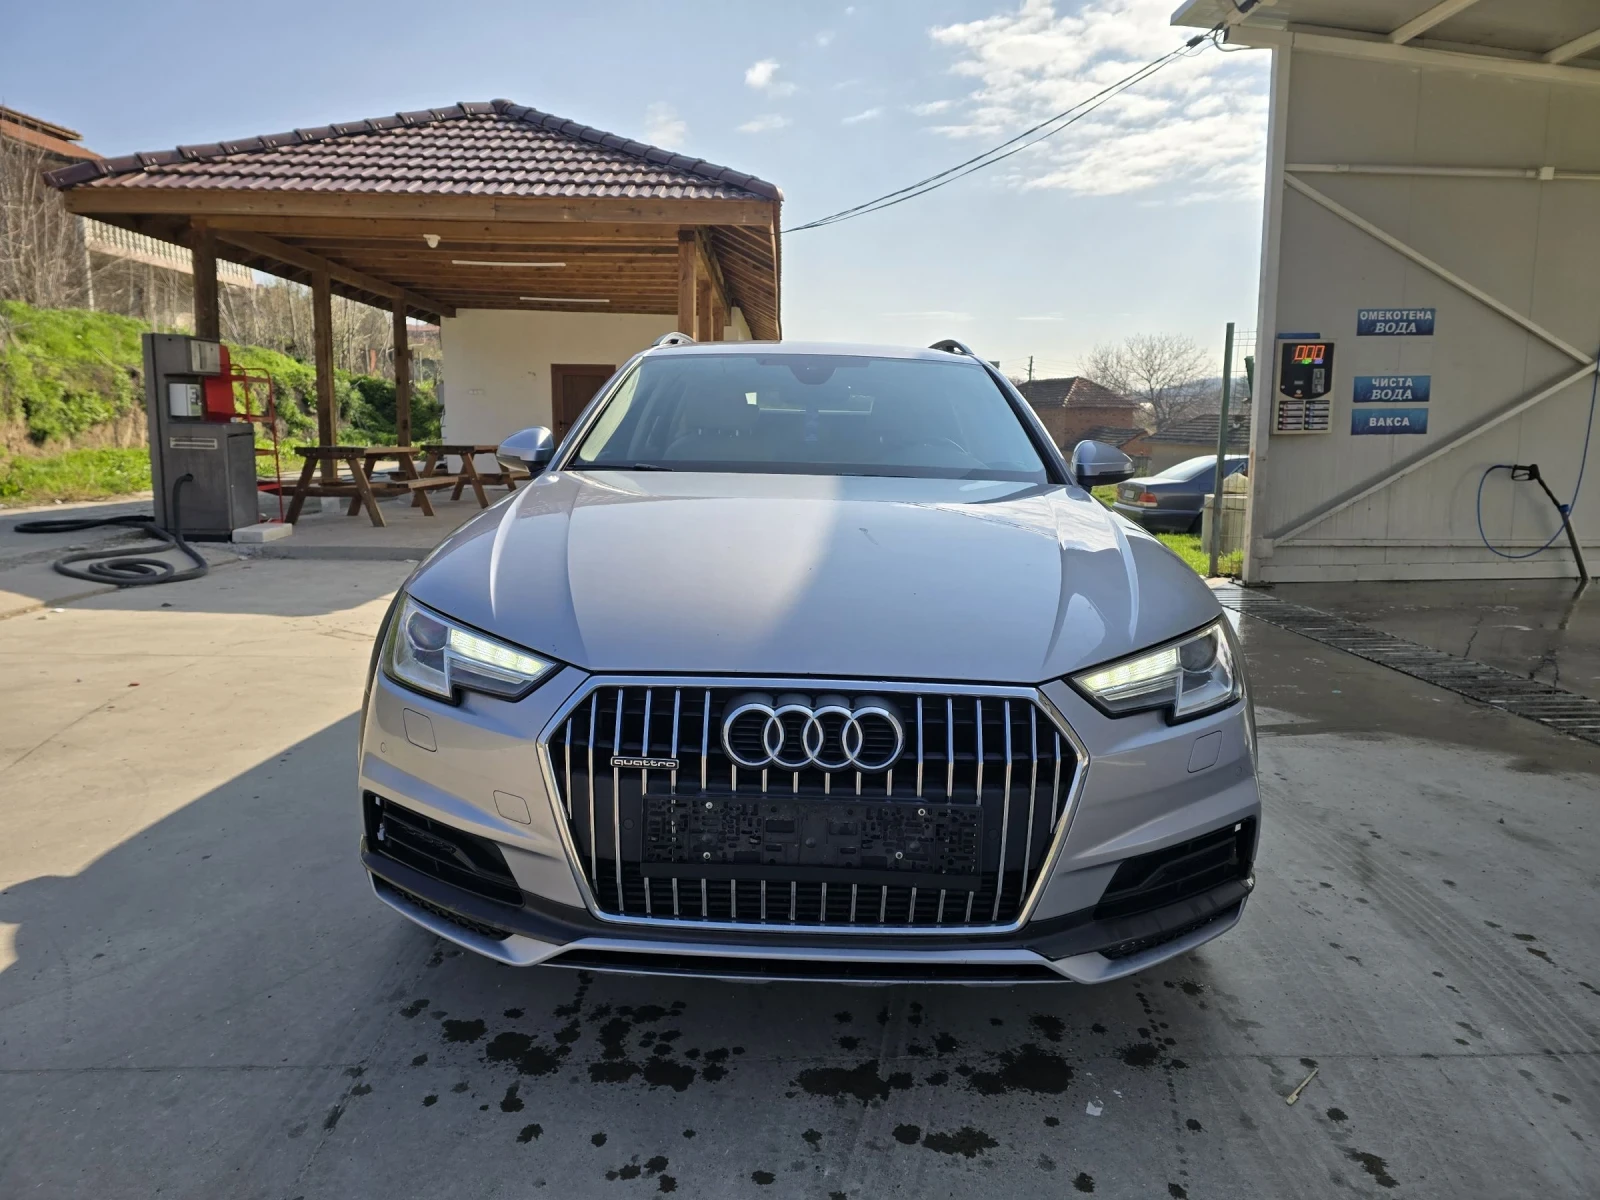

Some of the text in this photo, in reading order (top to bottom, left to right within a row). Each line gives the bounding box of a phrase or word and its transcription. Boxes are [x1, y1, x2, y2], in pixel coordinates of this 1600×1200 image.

[1359, 310, 1433, 320] ОМЕКОТЕНА
[1374, 322, 1417, 334] ВОДА
[1372, 377, 1413, 387] ЧИСТА
[1370, 389, 1413, 400] ВОДА
[1369, 417, 1410, 427] ВАКСА
[613, 759, 676, 768] quattro
